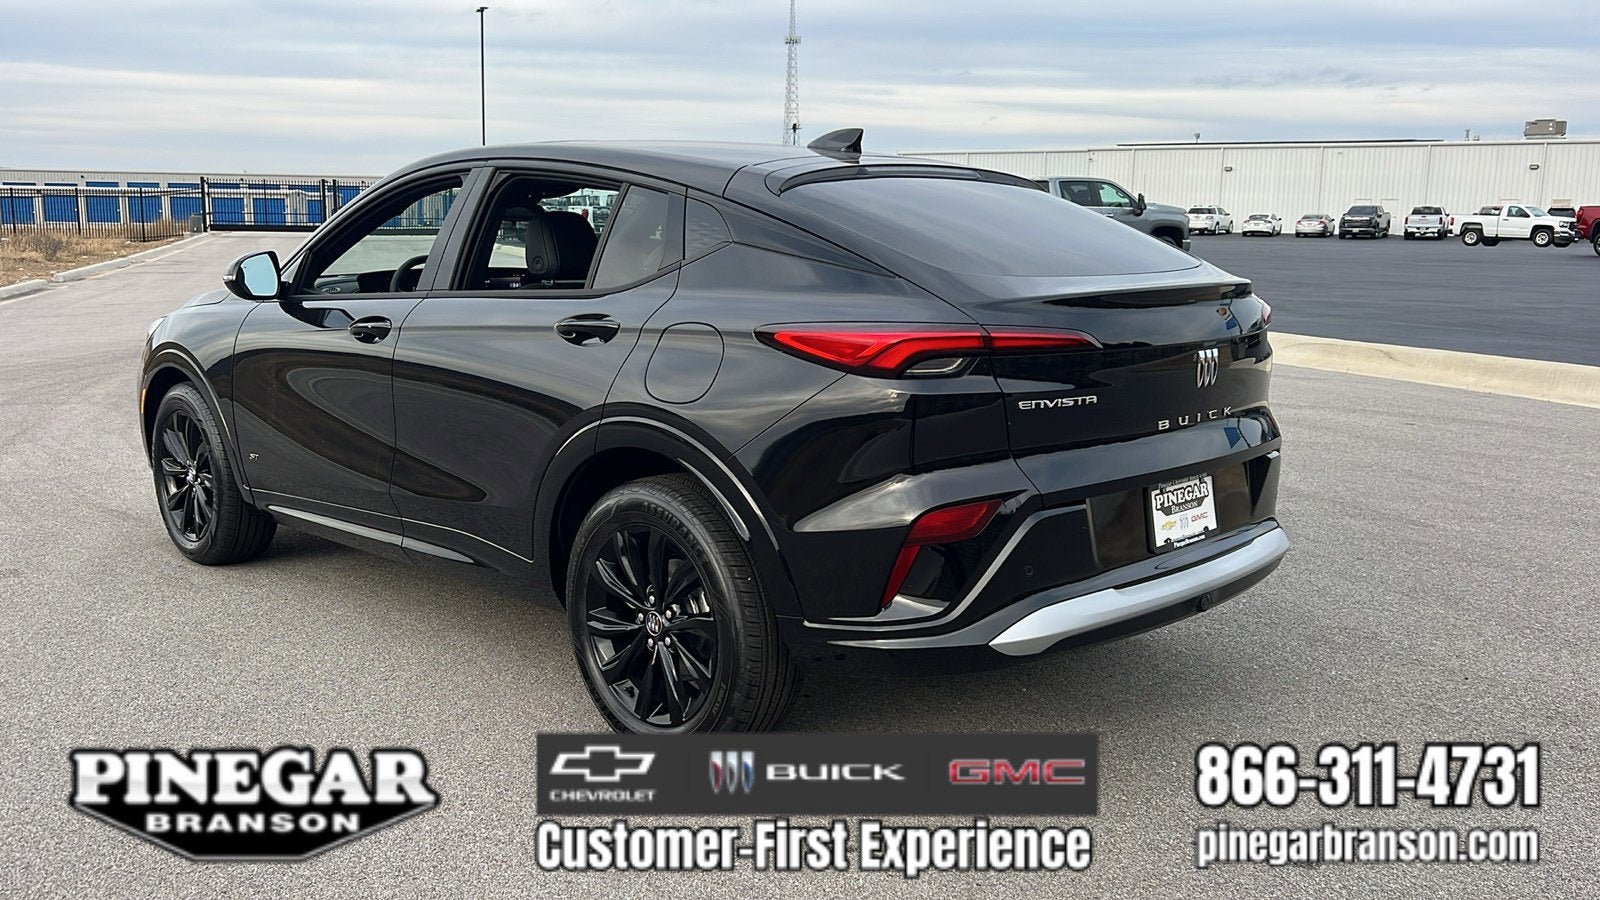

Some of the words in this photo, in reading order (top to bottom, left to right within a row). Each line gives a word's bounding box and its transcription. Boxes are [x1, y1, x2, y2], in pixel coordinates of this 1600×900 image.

[1018, 395, 1098, 411] ENVISTA
[1158, 406, 1233, 431] BUICK
[1155, 482, 1209, 510] PINEGAR
[1171, 500, 1199, 514] BRANSON
[1191, 511, 1208, 522] GMC
